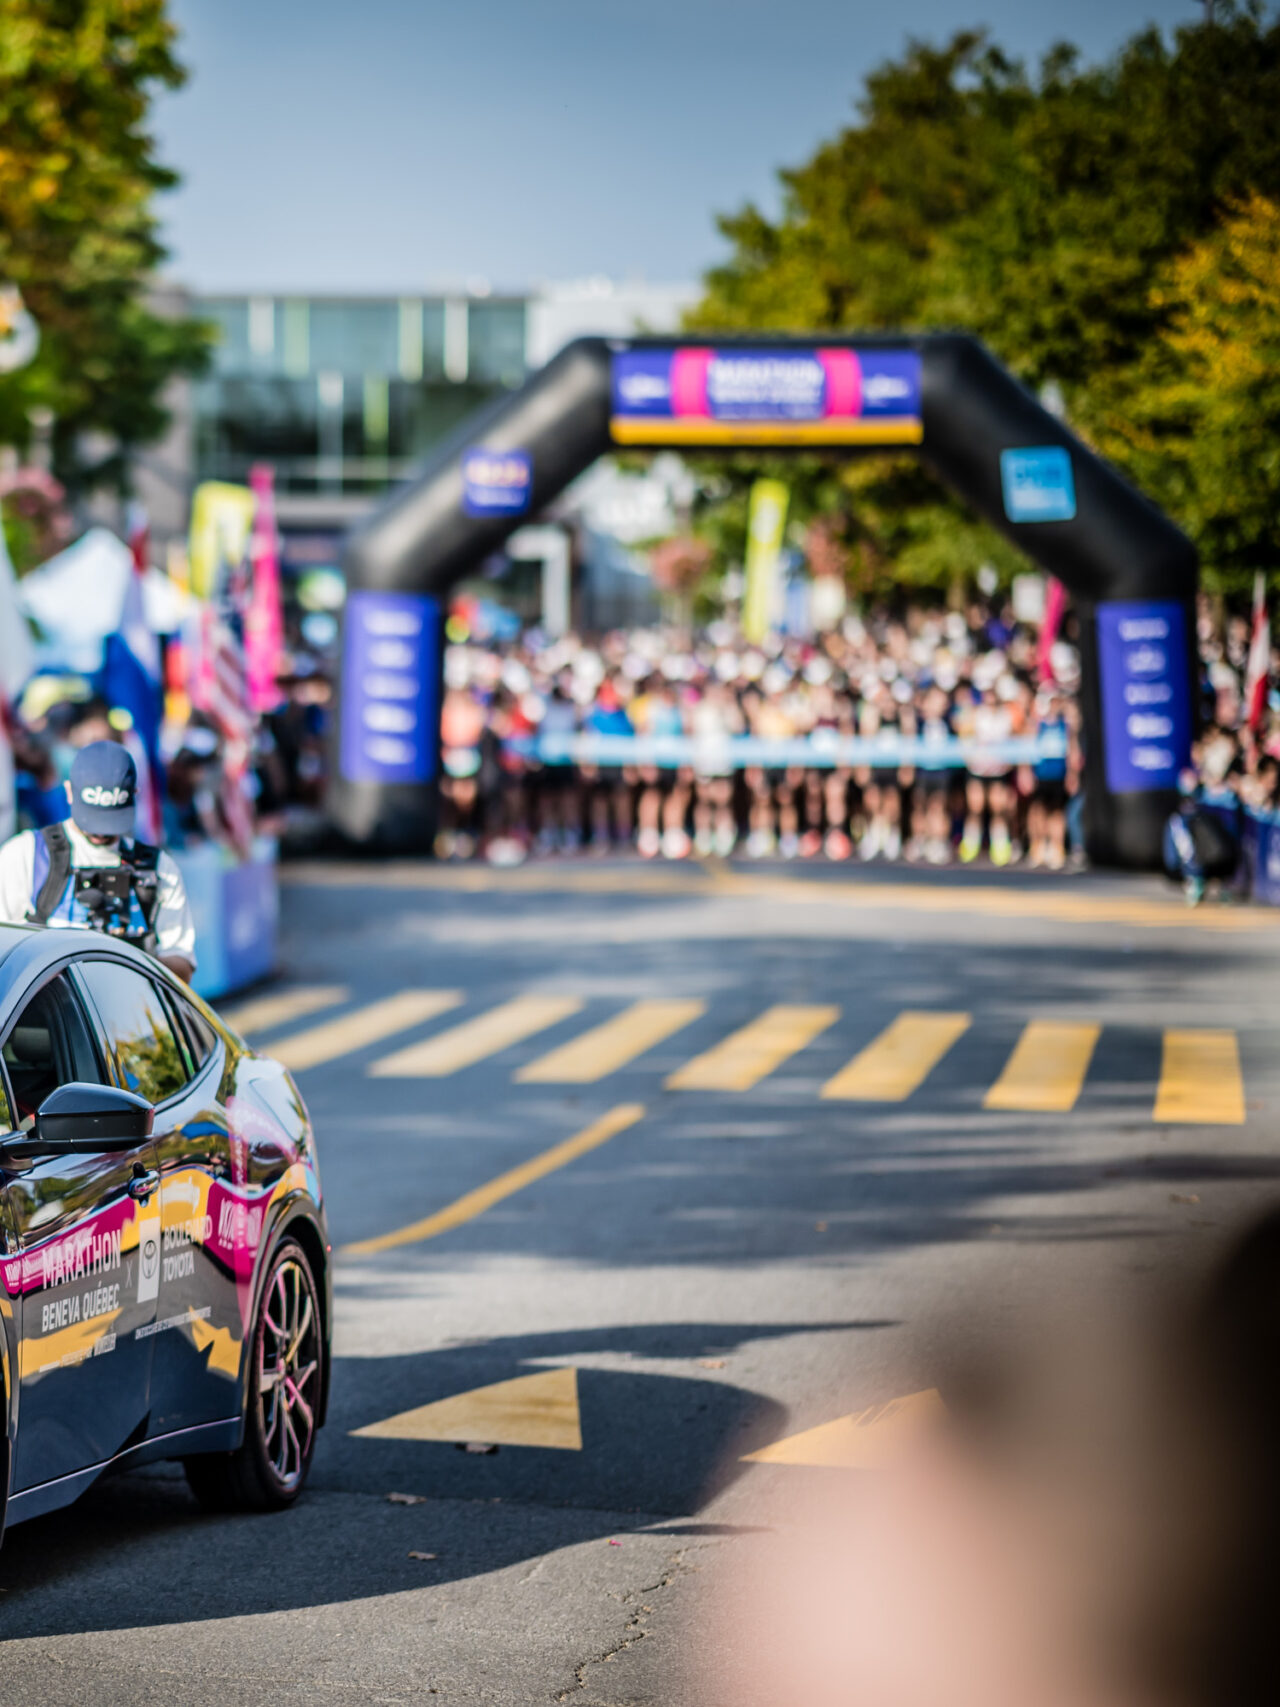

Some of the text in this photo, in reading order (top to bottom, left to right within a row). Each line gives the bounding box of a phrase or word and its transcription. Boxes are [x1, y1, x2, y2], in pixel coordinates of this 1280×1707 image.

[81, 786, 129, 807] ciele
[42, 1229, 121, 1290] MARATHON
[163, 1250, 195, 1283] TOYOTA
[41, 1280, 120, 1333] BENEVA QUÉBEC
